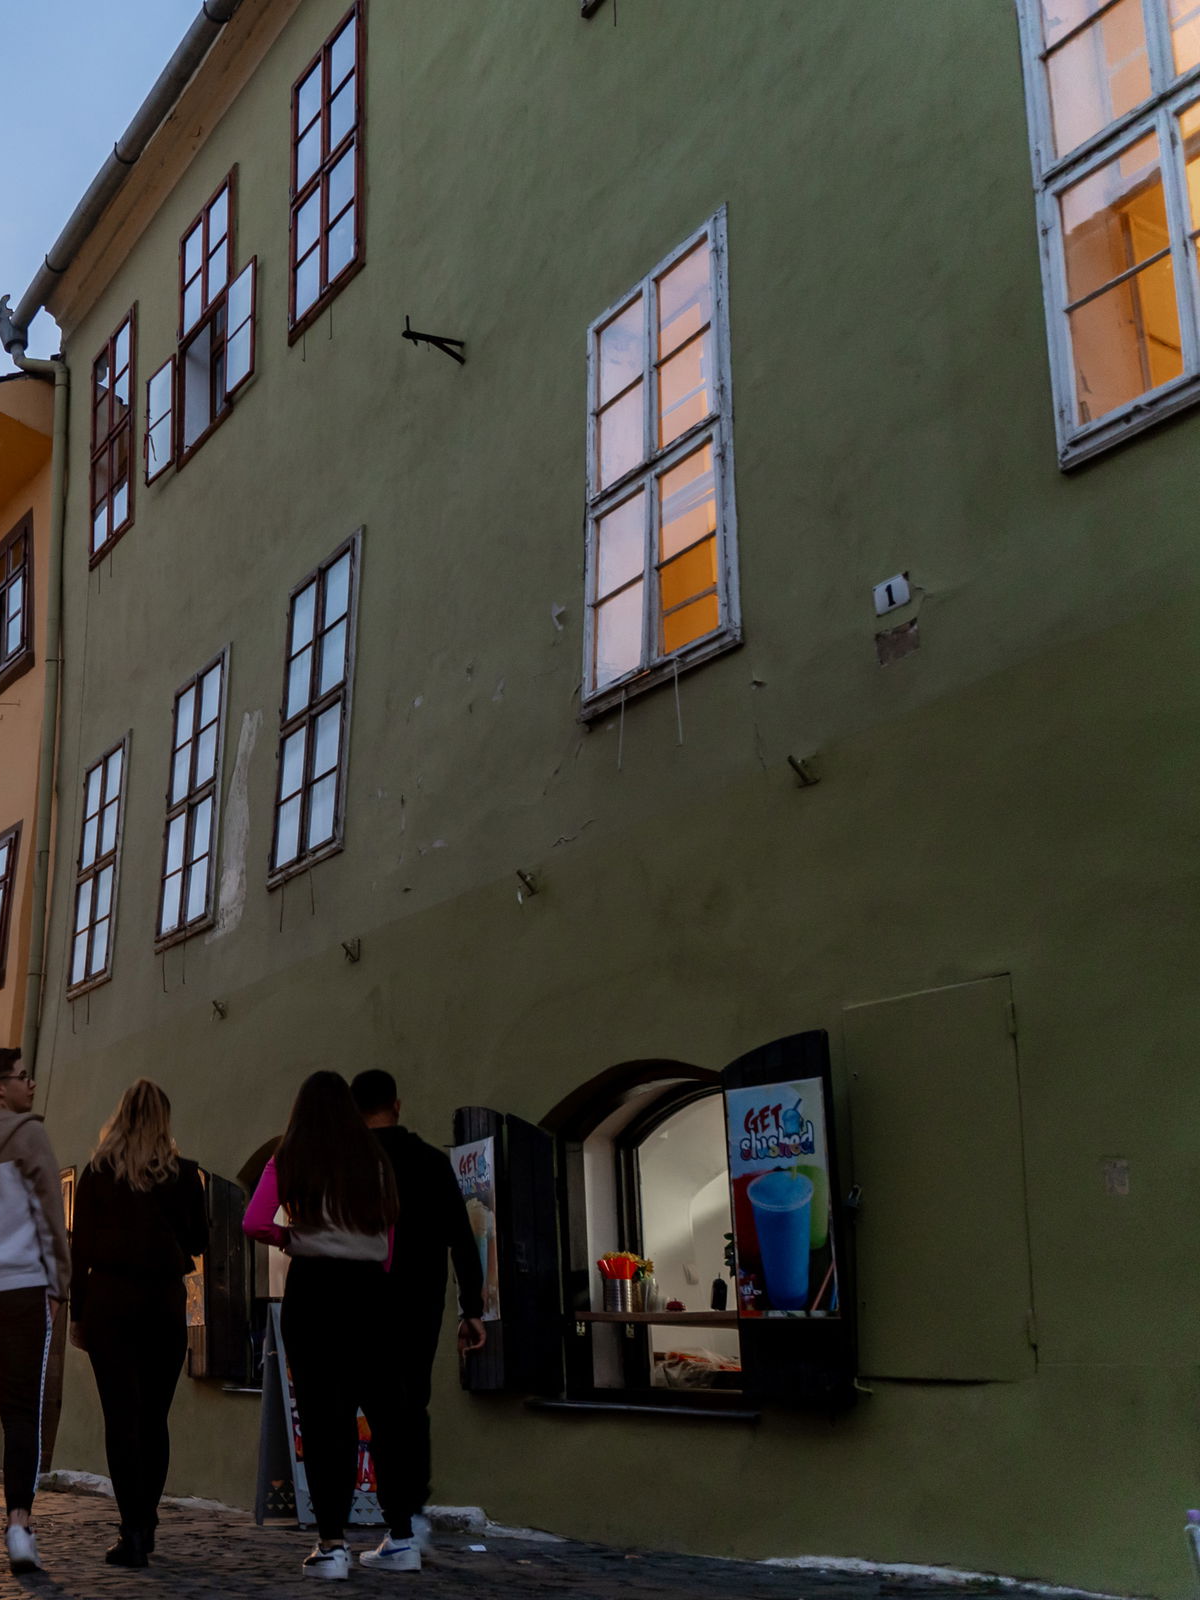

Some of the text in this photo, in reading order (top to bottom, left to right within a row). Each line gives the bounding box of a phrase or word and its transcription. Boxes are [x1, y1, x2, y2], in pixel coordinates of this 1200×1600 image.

[885, 583, 896, 607] 1
[743, 1103, 783, 1134] GET
[740, 1120, 815, 1161] slushed
[459, 1152, 478, 1176] GET
